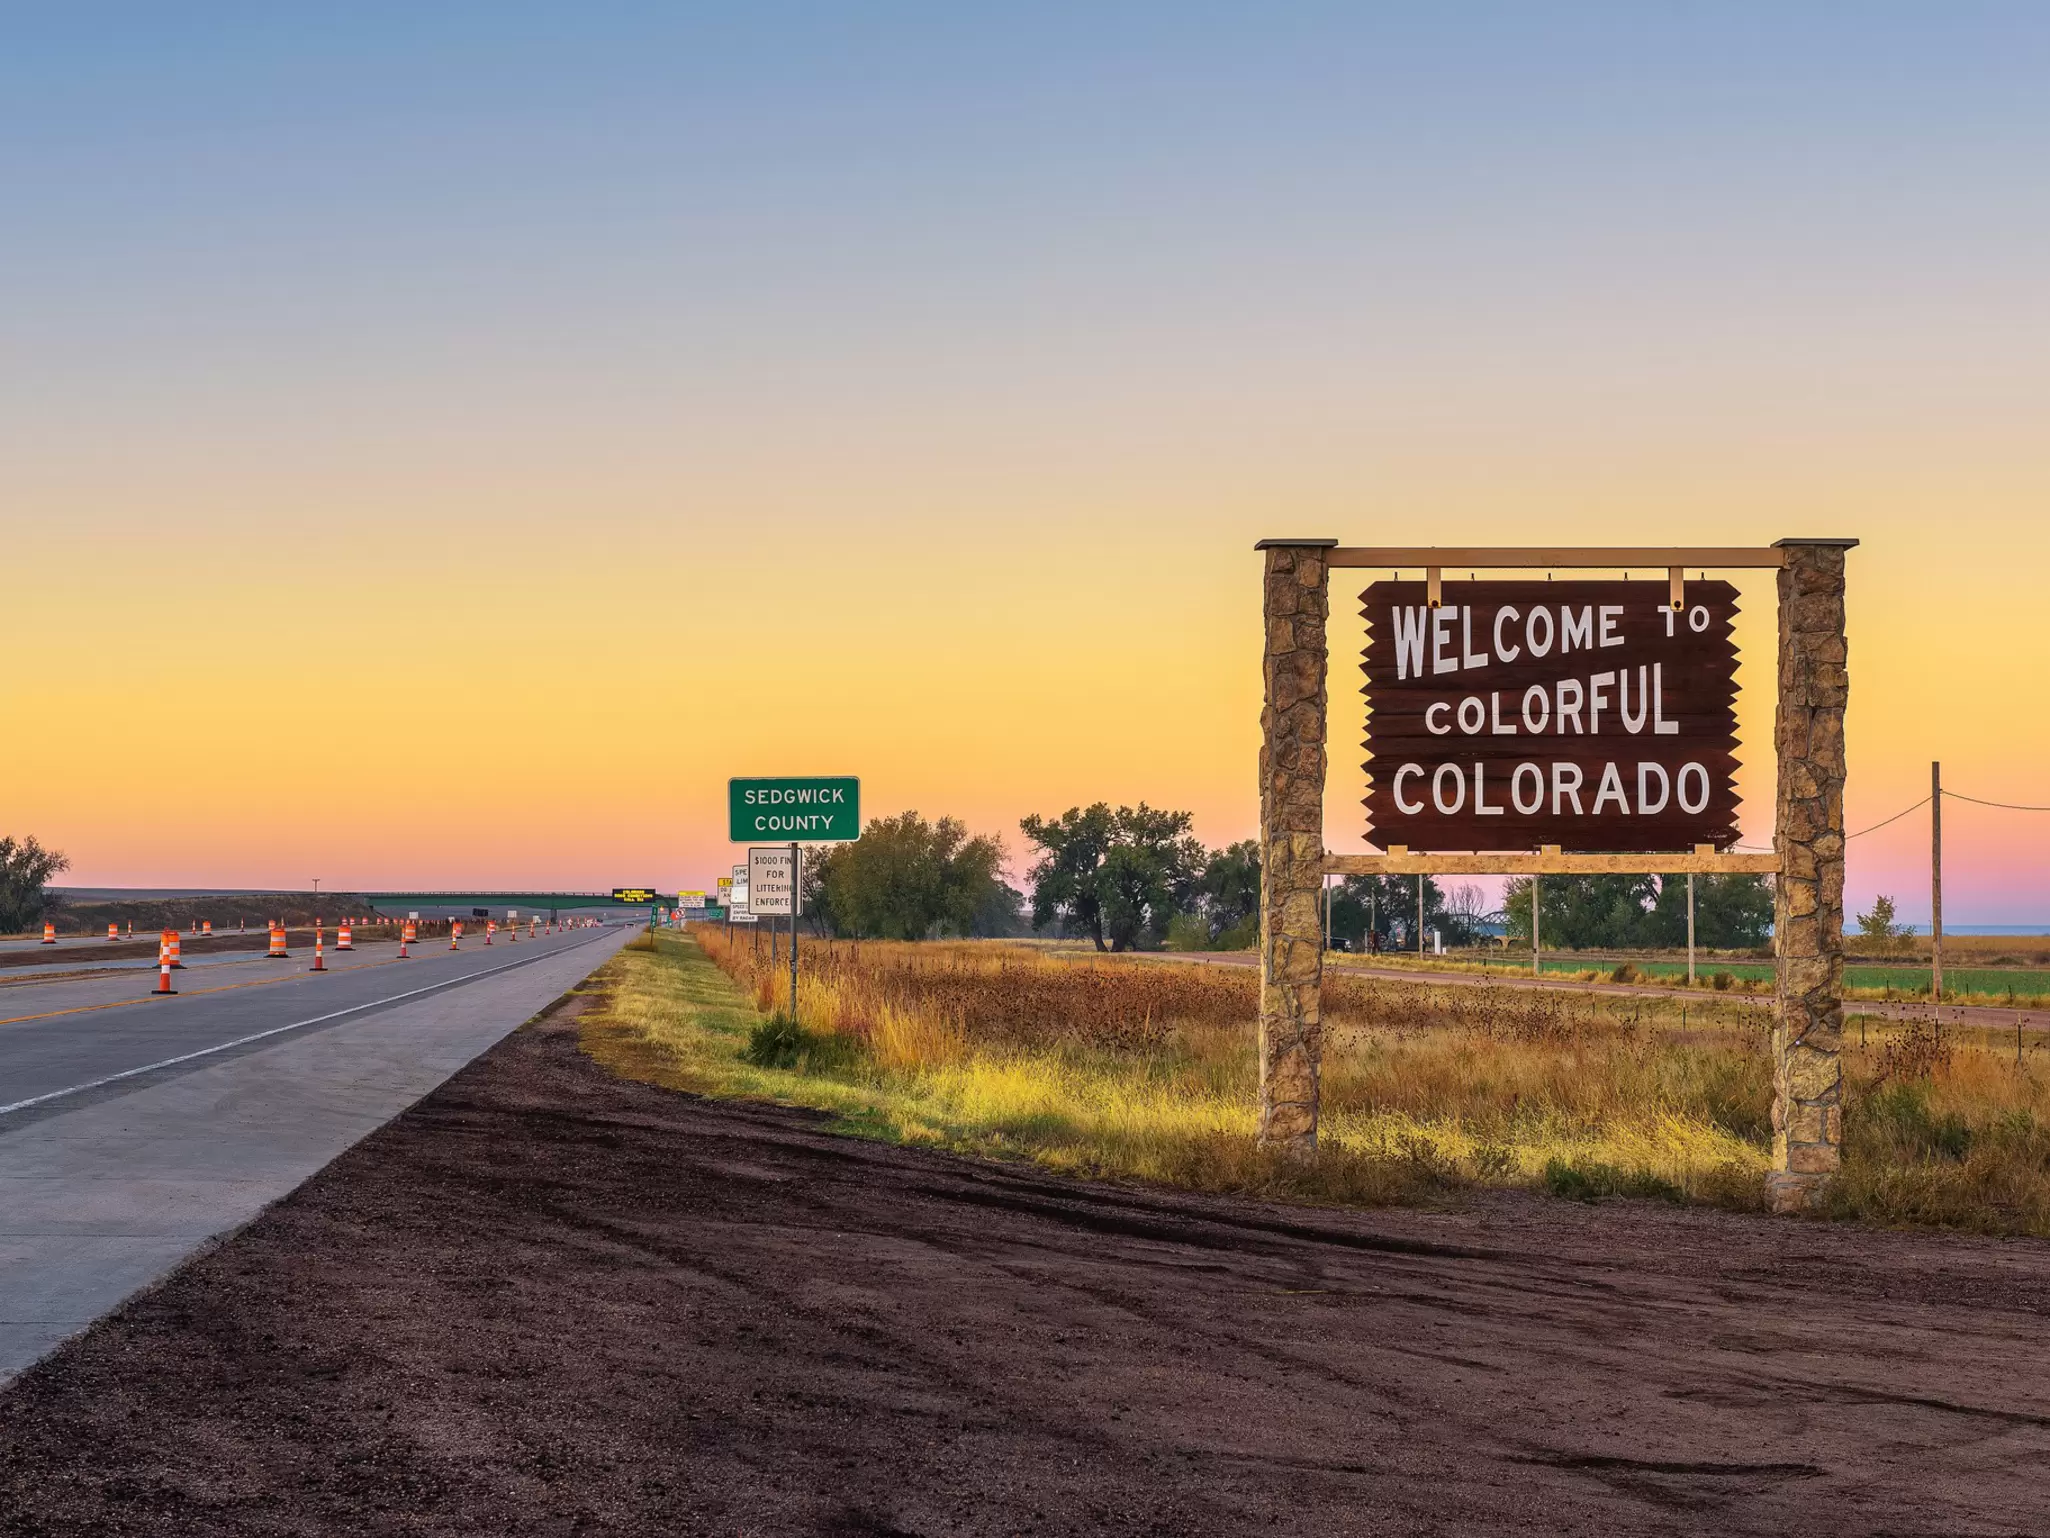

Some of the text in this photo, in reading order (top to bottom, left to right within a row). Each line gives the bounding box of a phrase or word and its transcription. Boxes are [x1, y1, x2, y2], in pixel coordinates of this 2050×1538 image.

[1392, 605, 1710, 680] WELCOME TO
[1425, 662, 1679, 735] COLORFUL
[1393, 762, 1710, 815] COLORADO
[744, 789, 844, 804] SEDGWICK
[755, 815, 834, 830] COUNTY
[755, 856, 792, 865] $1000 FIN
[766, 870, 785, 879] FOR
